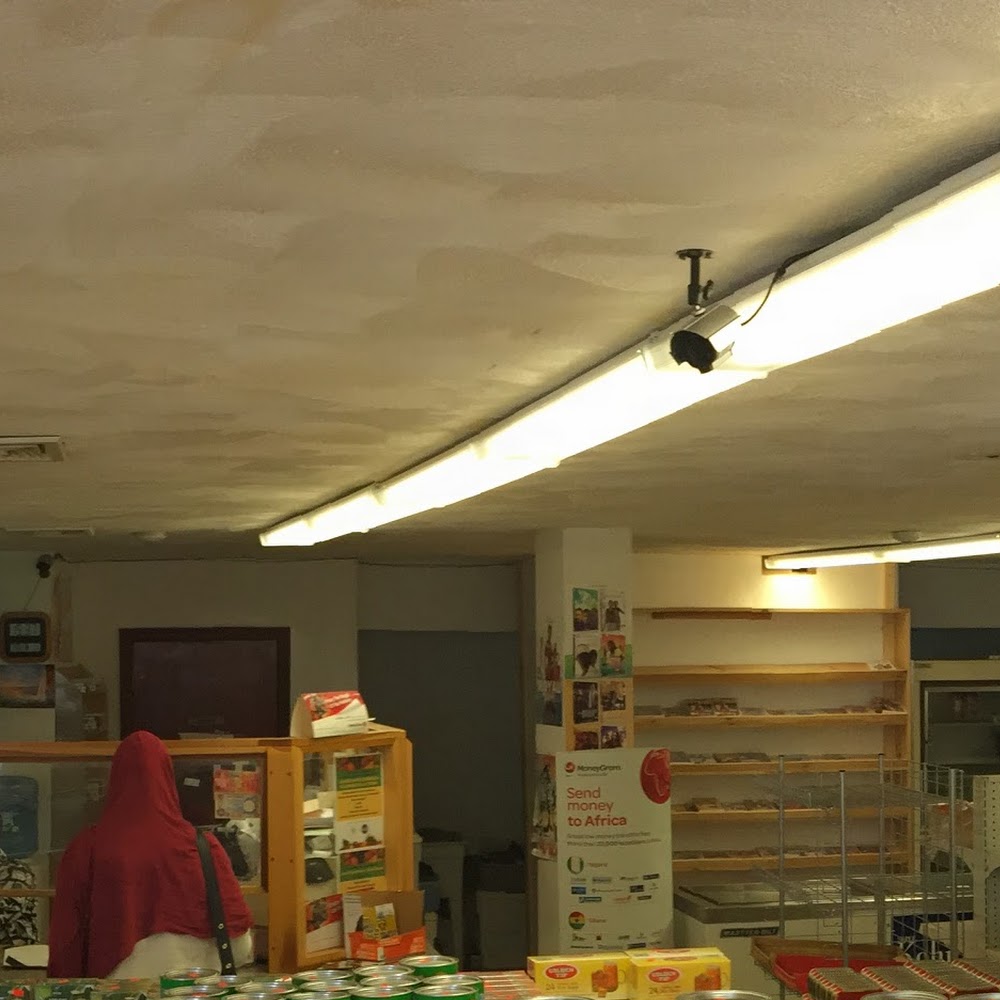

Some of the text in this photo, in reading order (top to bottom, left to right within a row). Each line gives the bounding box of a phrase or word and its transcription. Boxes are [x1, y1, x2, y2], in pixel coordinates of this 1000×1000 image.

[577, 763, 621, 773] MoneyGram
[567, 787, 601, 799] Send
[567, 802, 614, 813] money
[568, 814, 628, 827] to Africa
